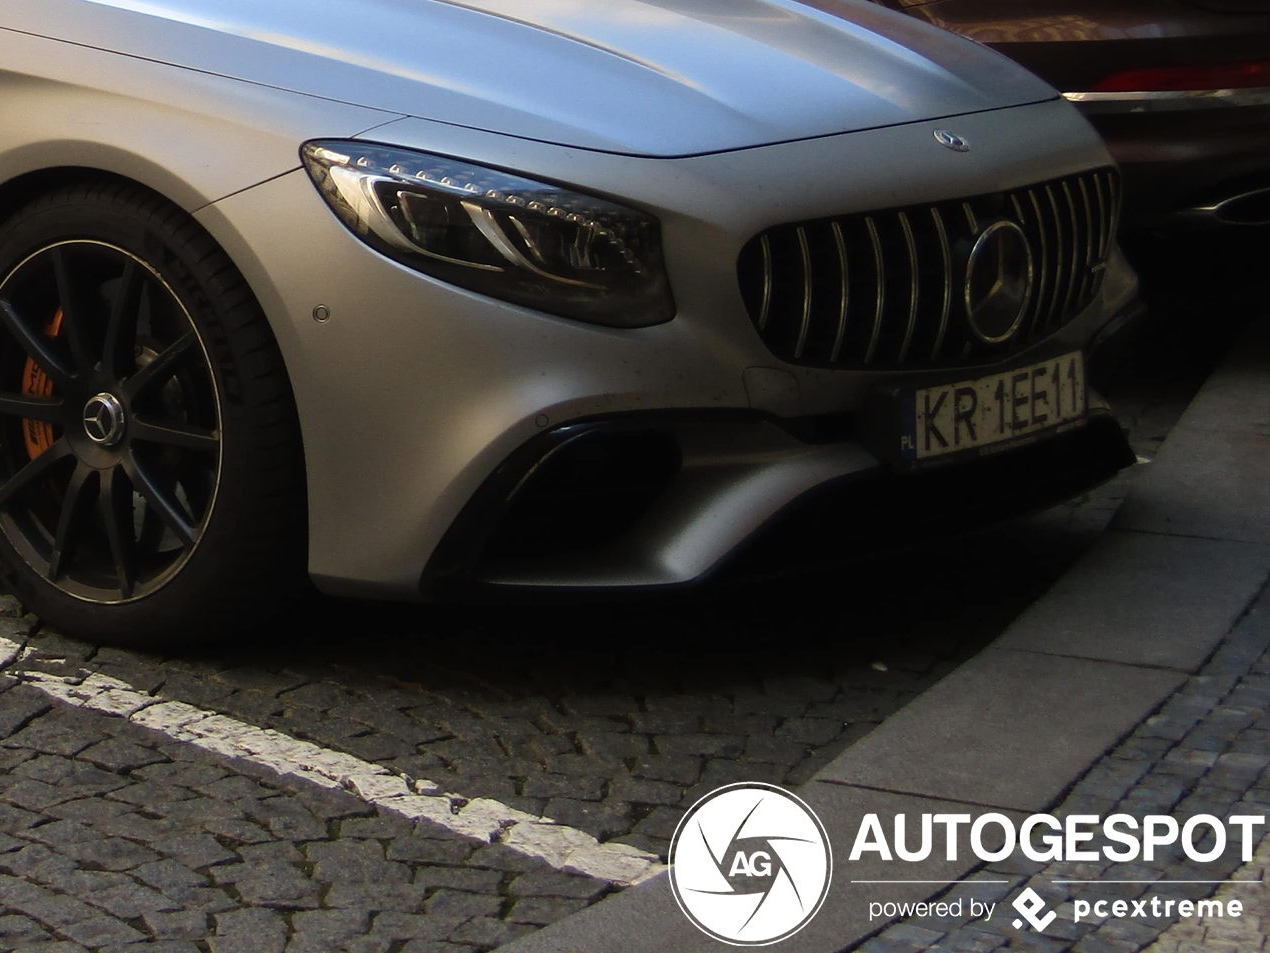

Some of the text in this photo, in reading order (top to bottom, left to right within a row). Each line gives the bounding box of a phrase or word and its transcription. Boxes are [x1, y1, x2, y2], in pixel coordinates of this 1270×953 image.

[924, 358, 1078, 451] KR 1EE11
[901, 435, 914, 451] PL
